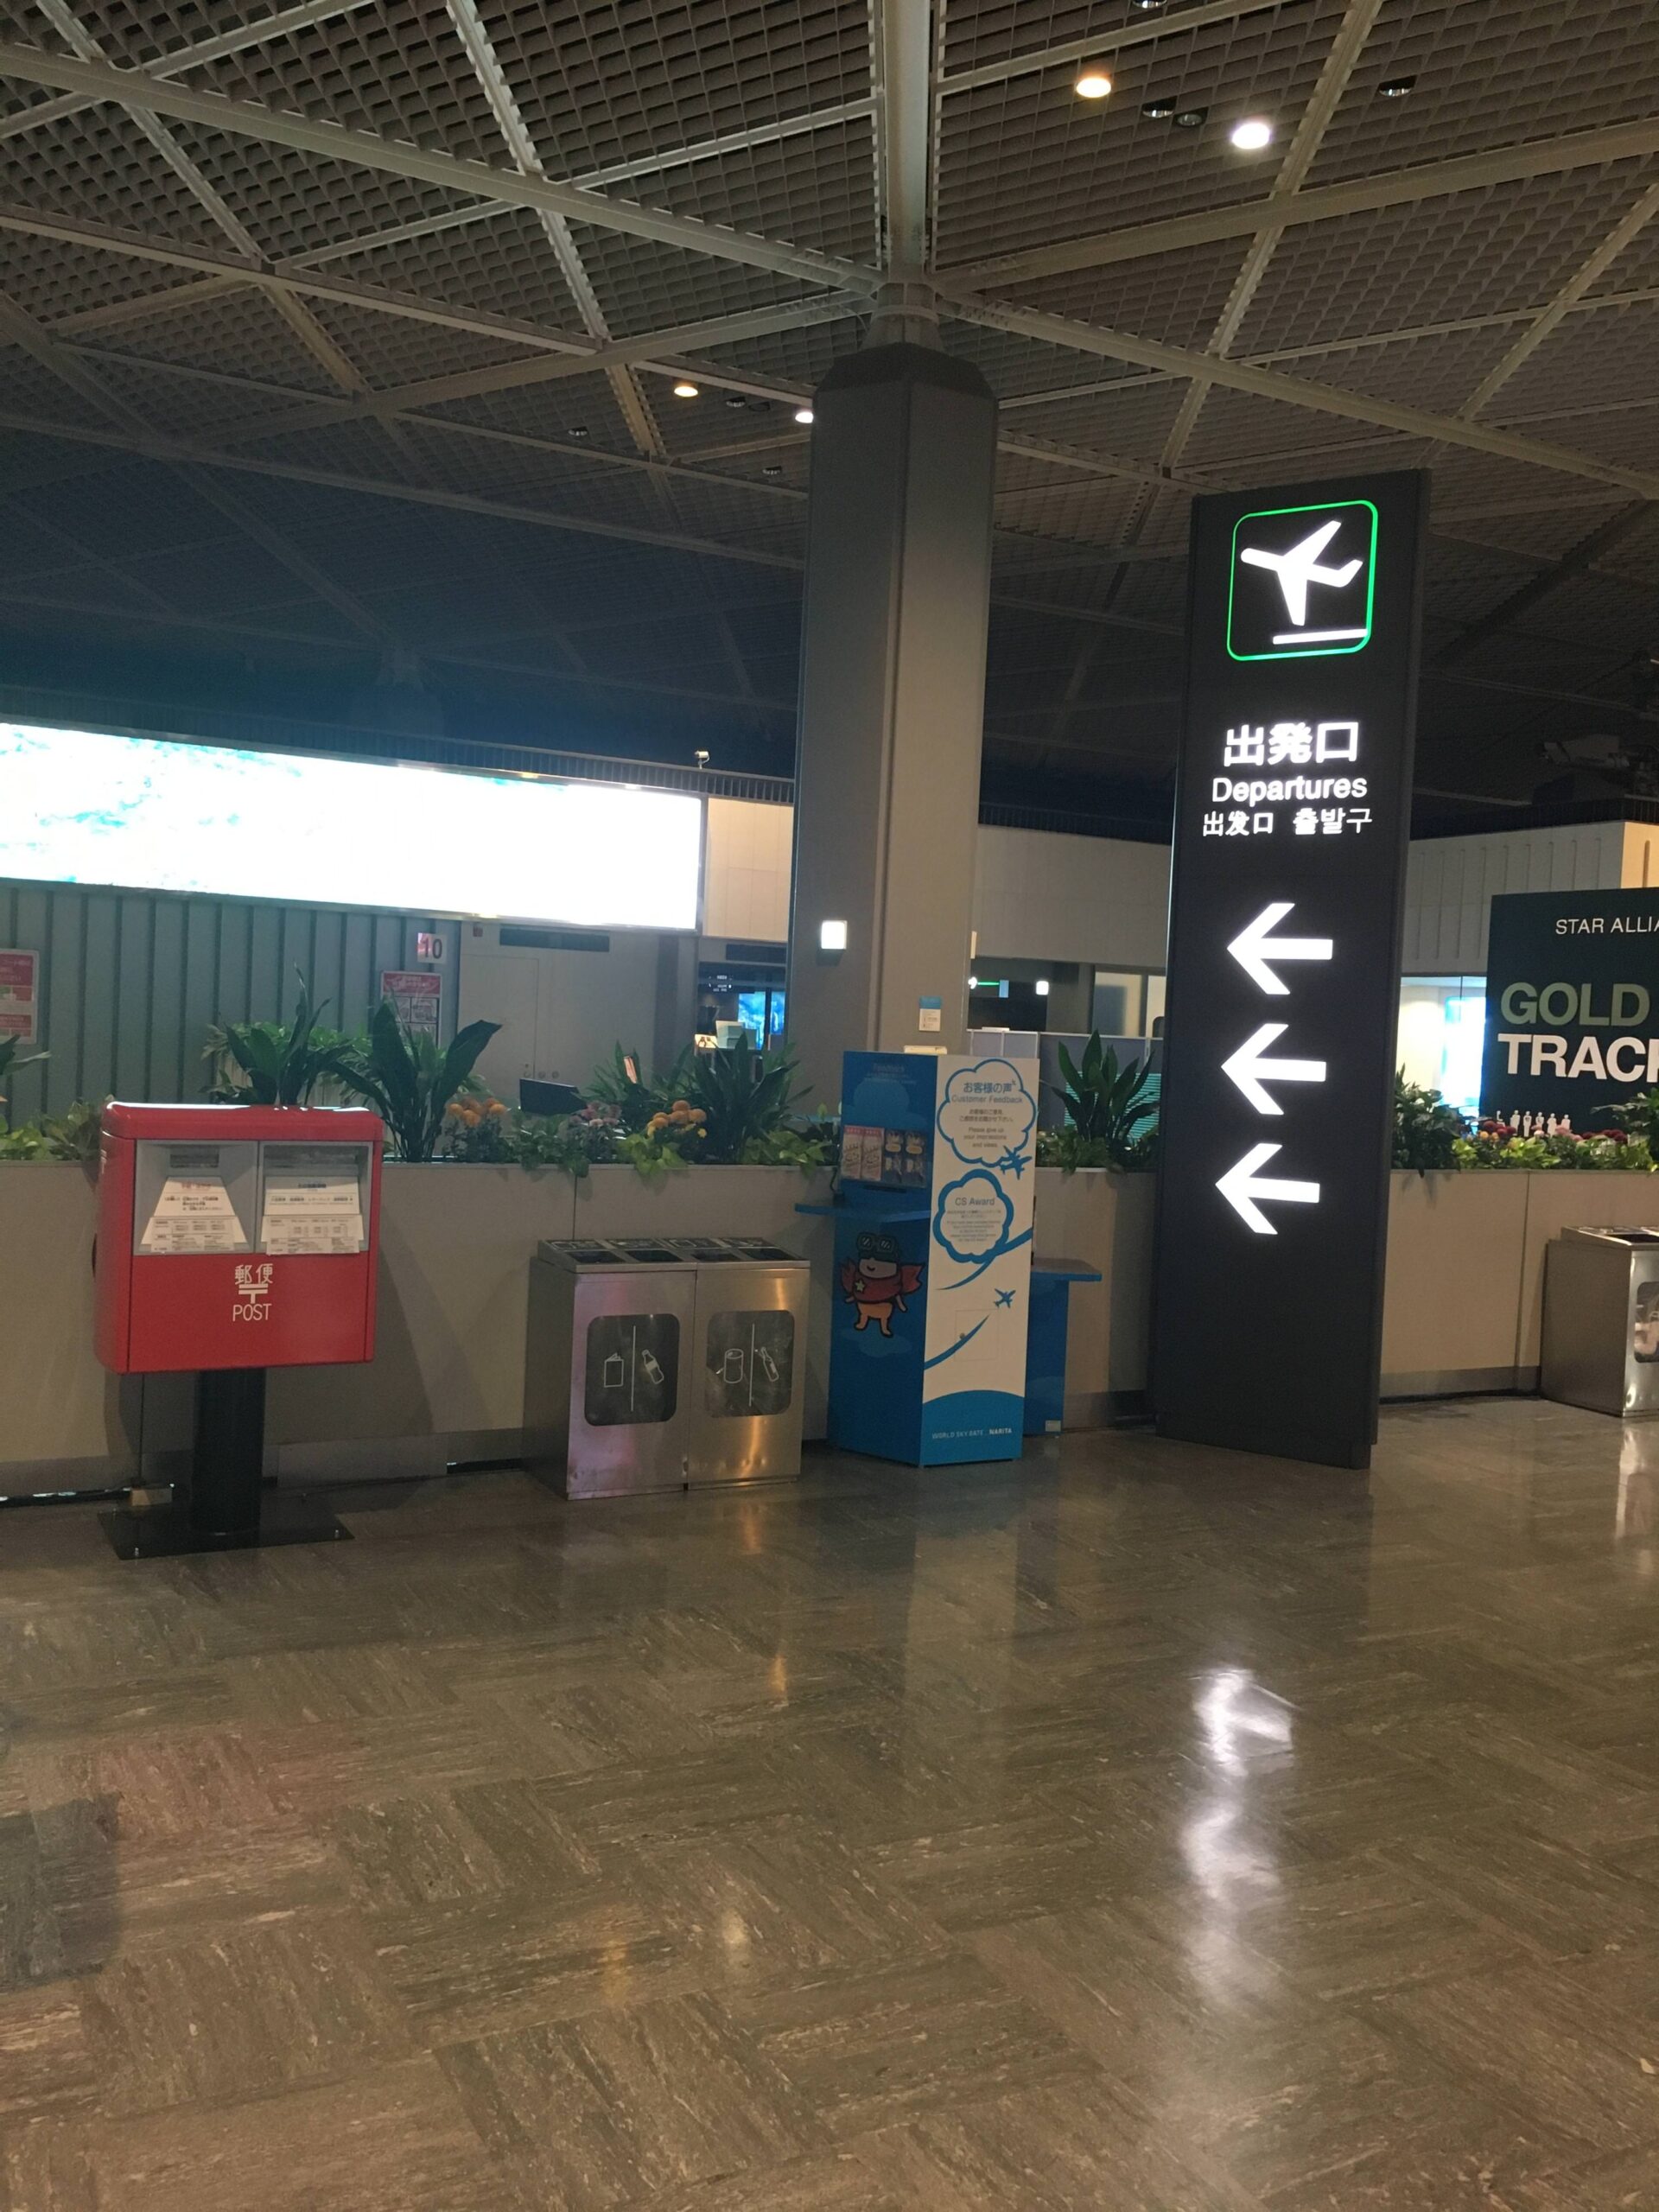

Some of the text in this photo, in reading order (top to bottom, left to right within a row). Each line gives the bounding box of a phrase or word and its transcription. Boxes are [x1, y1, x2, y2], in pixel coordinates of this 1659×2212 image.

[1224, 721, 1359, 767] 出発口
[1211, 775, 1368, 807] Departures
[1202, 807, 1372, 836] 出发口 출발구
[1554, 918, 1605, 936] STAR
[422, 938, 442, 959] 10
[1500, 982, 1650, 1027] GOLD
[963, 1081, 1013, 1095] お客様の声
[951, 1094, 1023, 1104] Customer Feedback
[954, 1197, 995, 1206] CS Award
[234, 1262, 274, 1286] 郵便
[232, 1303, 272, 1322] POST
